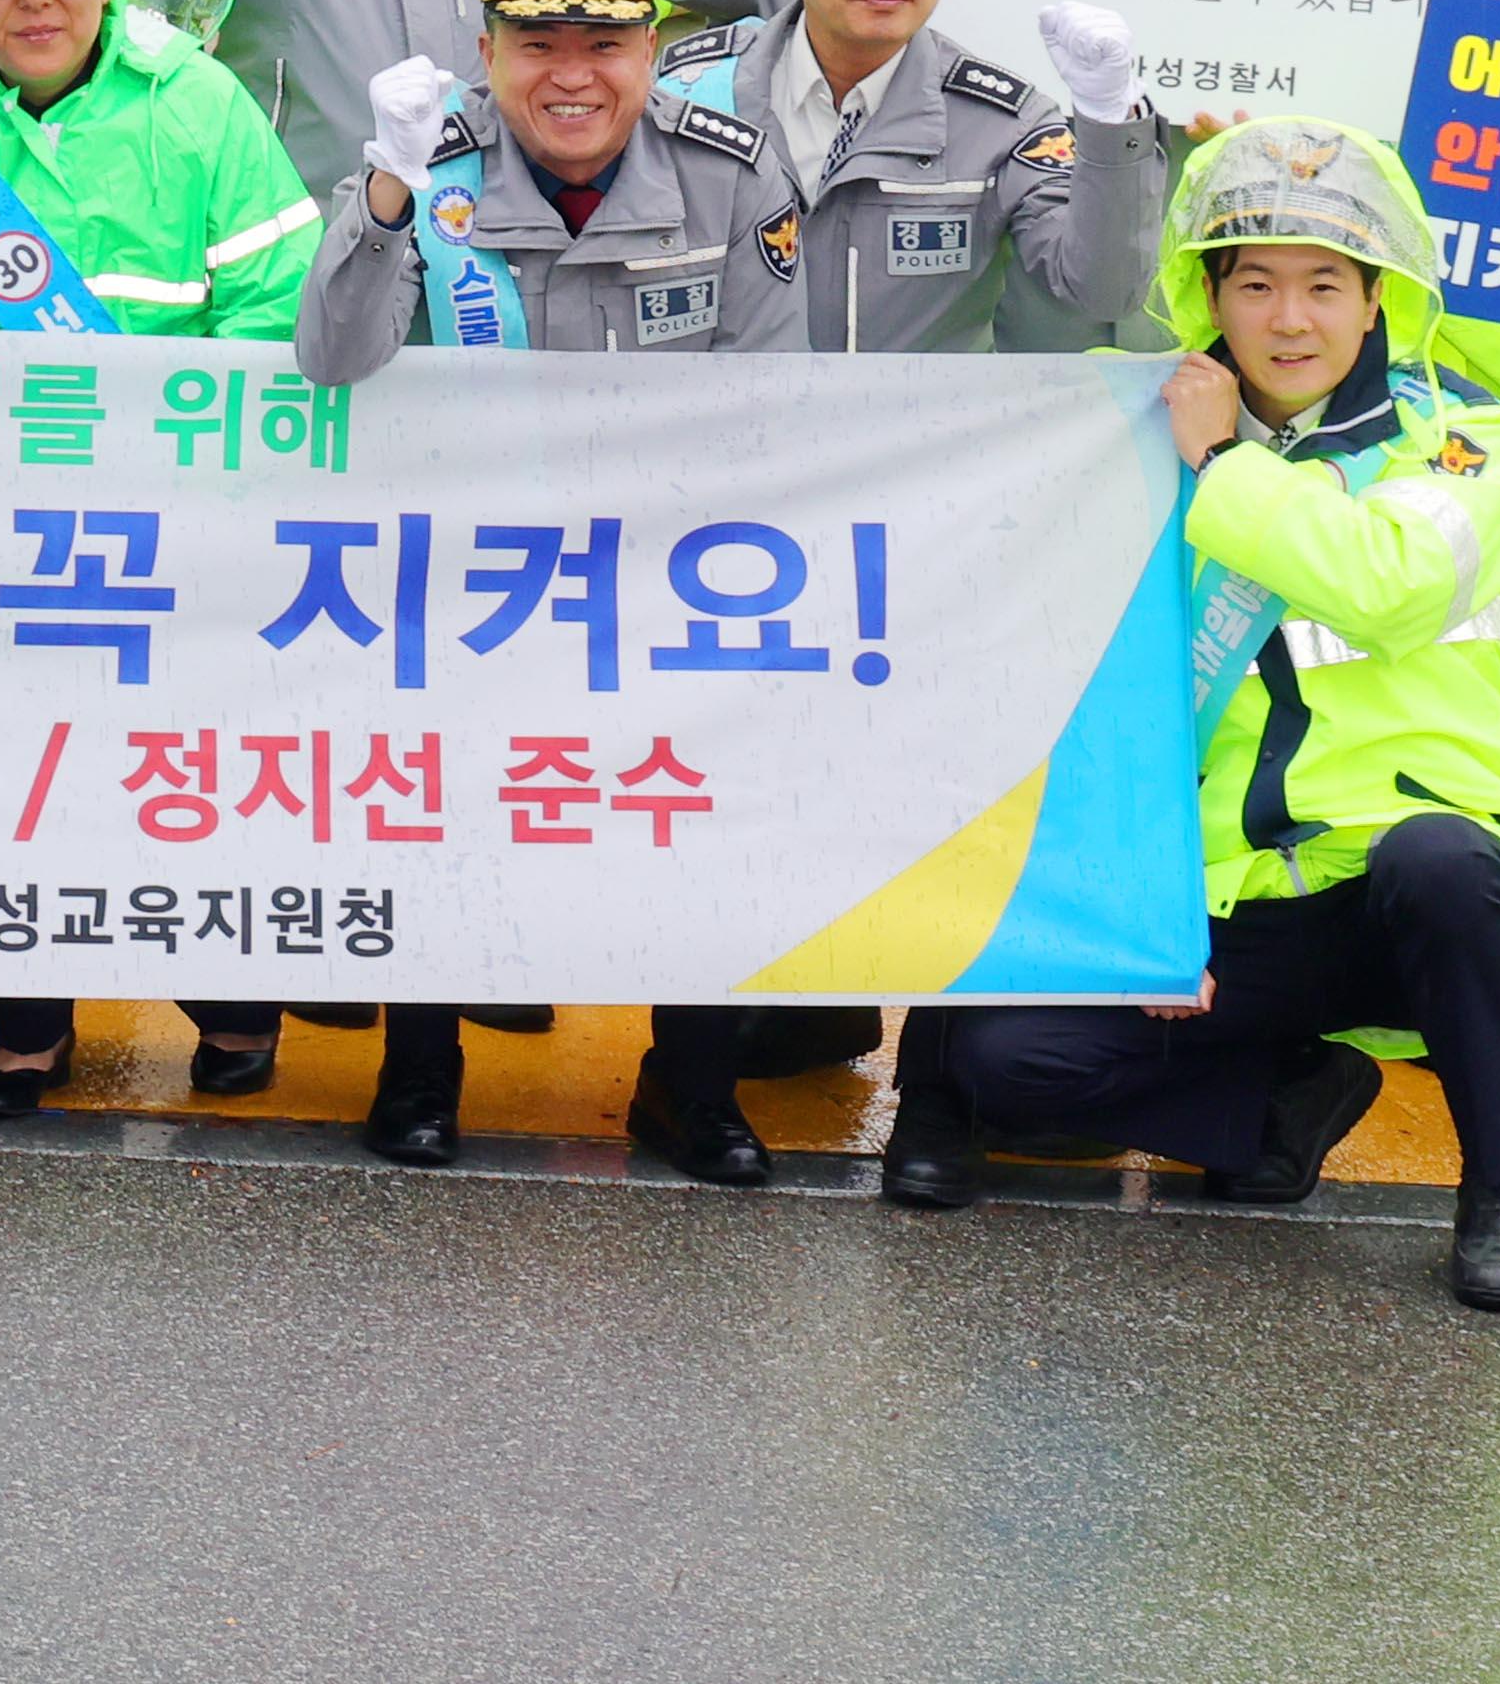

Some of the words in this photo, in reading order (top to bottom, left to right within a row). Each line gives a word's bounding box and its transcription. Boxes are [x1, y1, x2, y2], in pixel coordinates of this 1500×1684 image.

[896, 221, 962, 250] 경찰
[896, 252, 963, 268] POLICE
[645, 284, 710, 318] 경찰
[646, 312, 711, 337] POLICE
[154, 370, 352, 474] 위해
[261, 515, 891, 692] 지켜요!
[16, 724, 71, 842] /
[124, 730, 444, 843] 정지선
[500, 738, 713, 848] 준수
